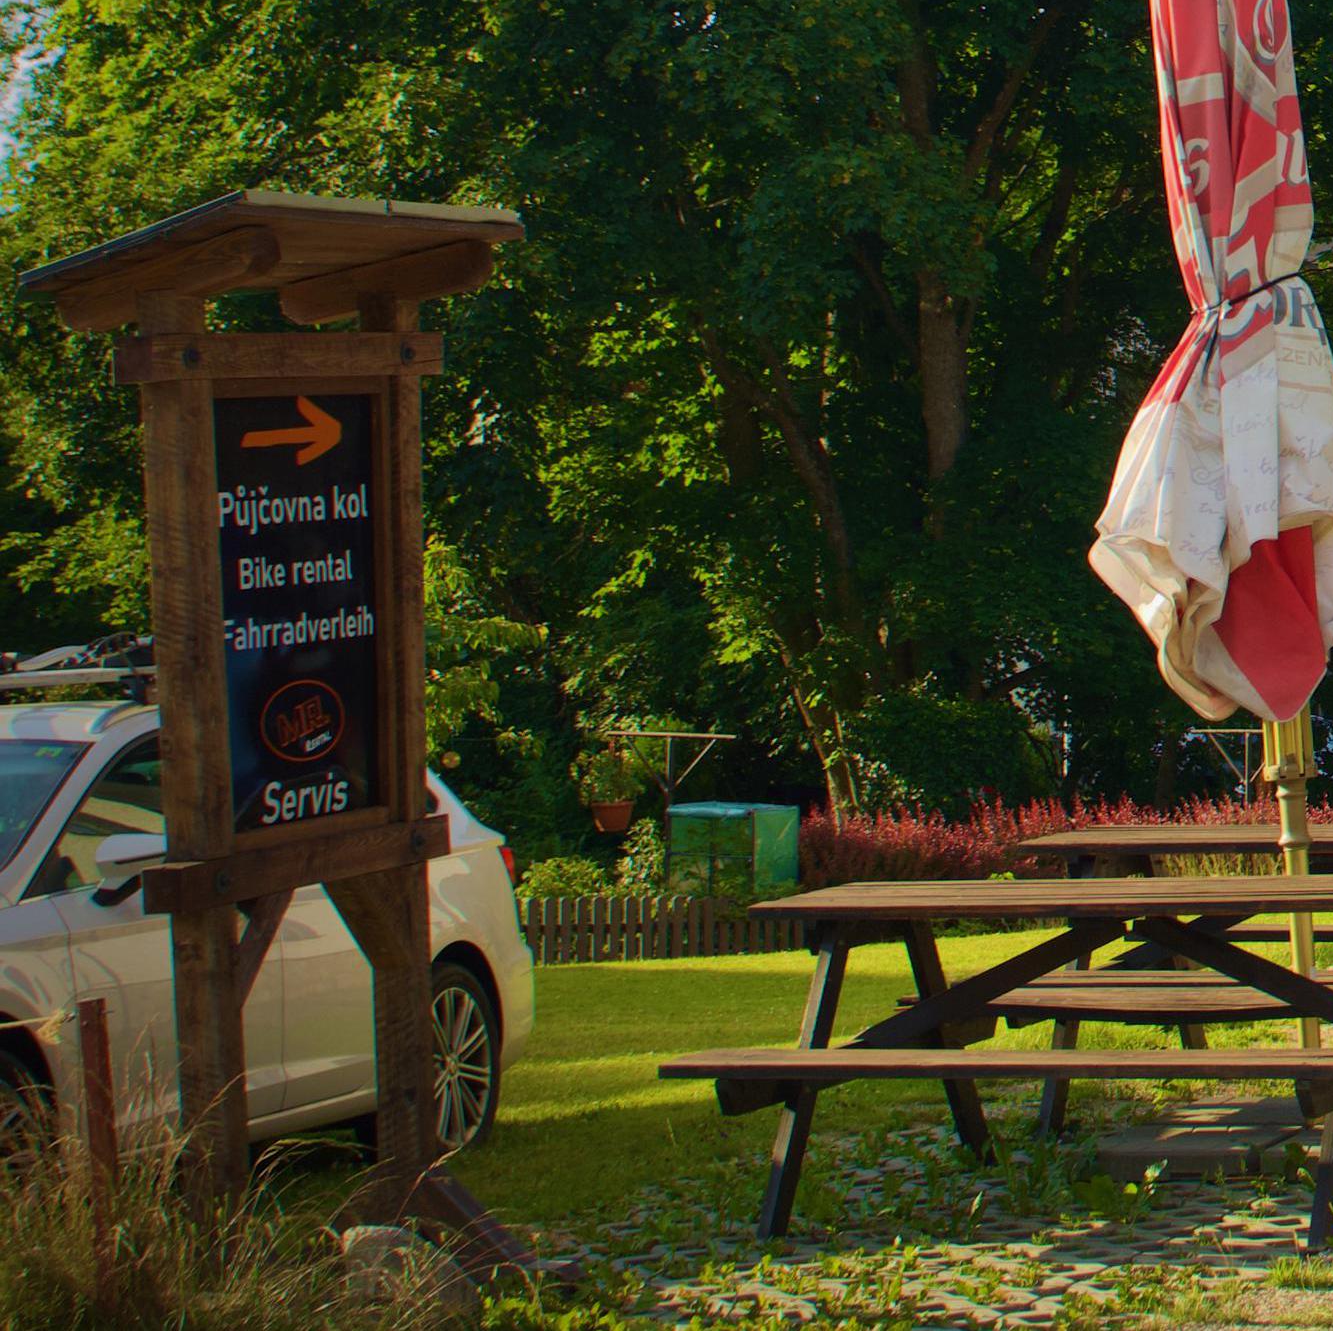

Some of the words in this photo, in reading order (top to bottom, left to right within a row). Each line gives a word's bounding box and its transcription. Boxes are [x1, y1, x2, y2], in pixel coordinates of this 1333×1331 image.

[218, 485, 326, 536] Půjčovna
[333, 483, 368, 521] kol
[238, 556, 286, 591] Bike
[292, 550, 352, 585] rental
[262, 772, 349, 824] Servis
